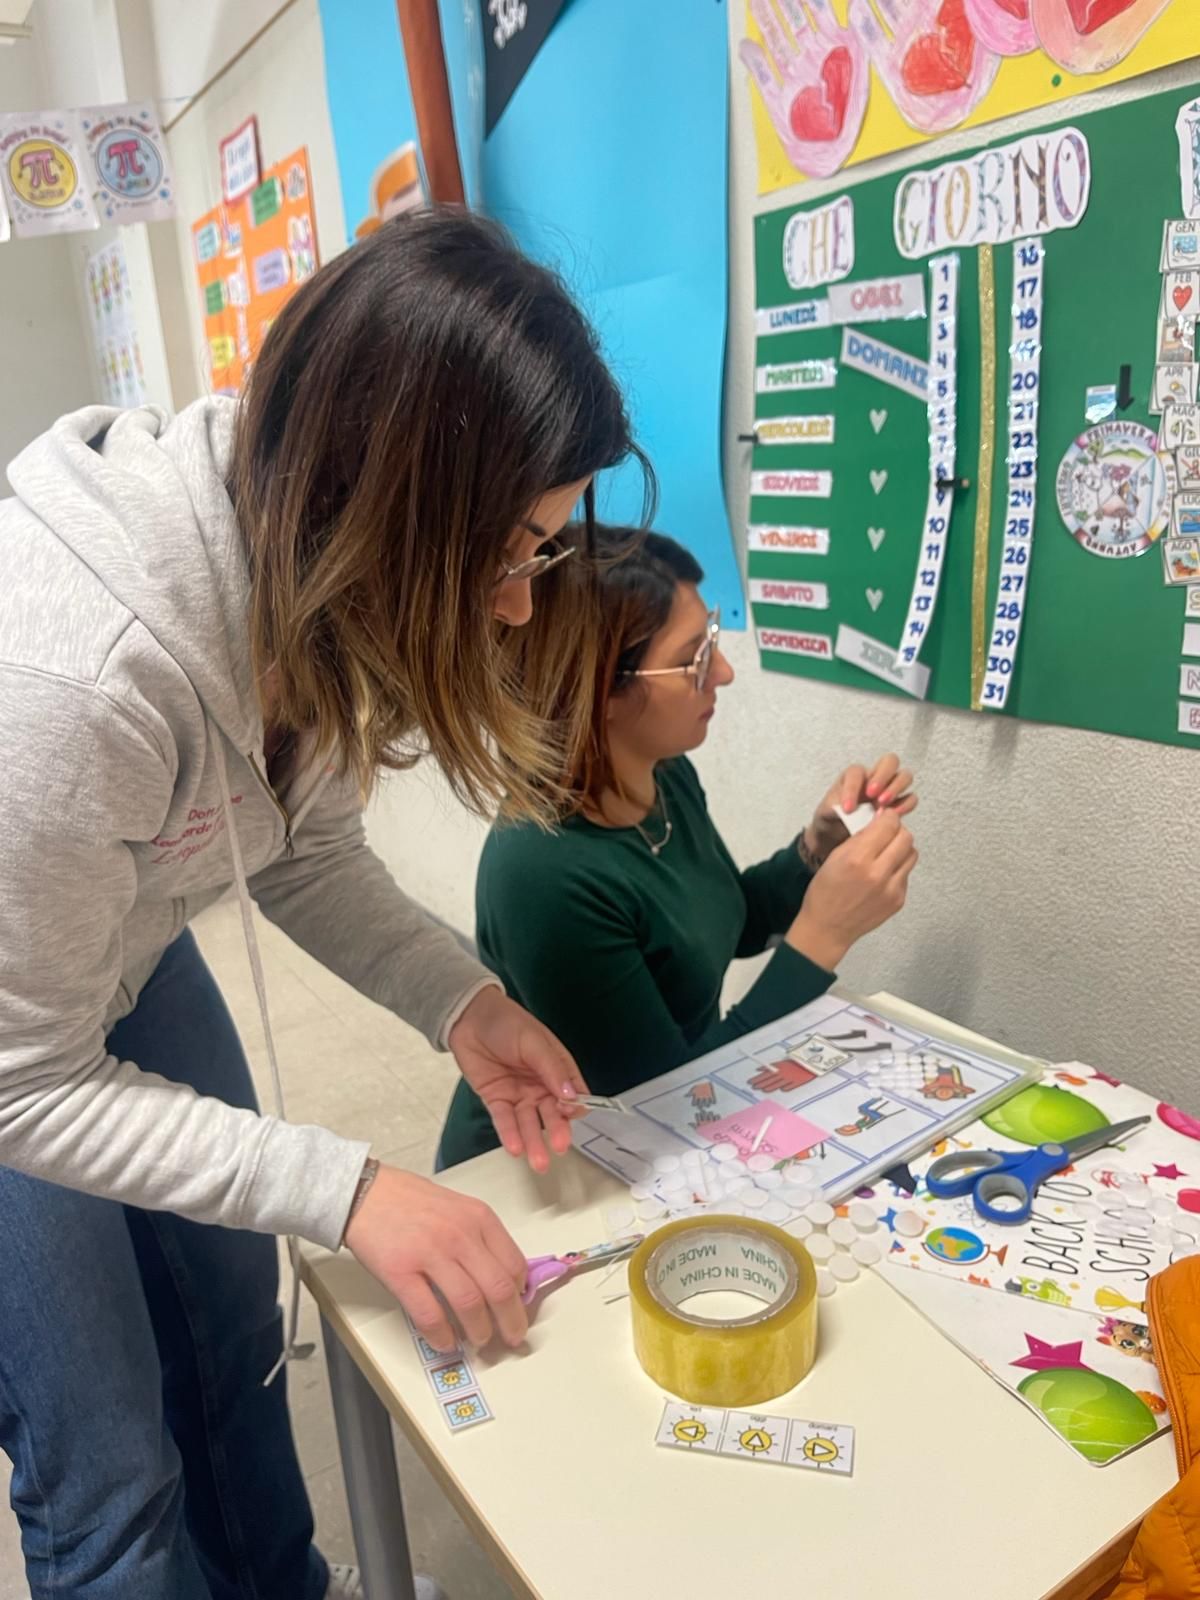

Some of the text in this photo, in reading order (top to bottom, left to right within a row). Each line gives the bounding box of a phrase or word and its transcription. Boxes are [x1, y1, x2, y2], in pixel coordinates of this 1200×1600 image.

[786, 198, 850, 284] CHE
[899, 134, 1088, 252] GIORNO
[1175, 222, 1195, 233] GEN
[1018, 245, 1039, 267] 16
[941, 264, 948, 281] 1
[1017, 277, 1038, 298] 17
[938, 294, 948, 311] 2
[1016, 308, 1037, 330] 18
[938, 323, 948, 340] 3
[847, 335, 929, 391] DOMANI
[937, 351, 947, 369] 4
[1012, 371, 1037, 391] 20
[1165, 367, 1184, 377] APR
[937, 380, 947, 397] 5
[1014, 401, 1034, 420] 21
[1172, 407, 1195, 417] MAG
[1011, 432, 1034, 449] 22
[1087, 423, 1154, 442] PRIMAVERA
[937, 436, 947, 452] 7
[1010, 461, 1033, 478] 23
[1010, 490, 1032, 508] 24
[928, 517, 946, 533] 10
[1007, 519, 1030, 537] 25
[926, 544, 940, 560] 11
[1171, 541, 1192, 551] AGO
[1004, 546, 1027, 565] 26
[920, 570, 936, 586] 12
[1001, 575, 1024, 592] 27
[761, 583, 814, 603] SABATO
[915, 596, 932, 611] 13
[996, 602, 1020, 620] 28
[909, 620, 925, 637] 14
[760, 631, 828, 655] DOMENICA
[993, 629, 1016, 647] 29
[902, 646, 916, 662] 15
[987, 655, 1012, 674] 30
[984, 683, 1005, 703] 31
[1021, 1211, 1087, 1275] BACK
[666, 1244, 717, 1275] MADE IN
[740, 1246, 777, 1273] CHINA
[680, 1266, 721, 1287] CHINA
[725, 1267, 739, 1279] IN
[743, 1268, 777, 1294] MADE
